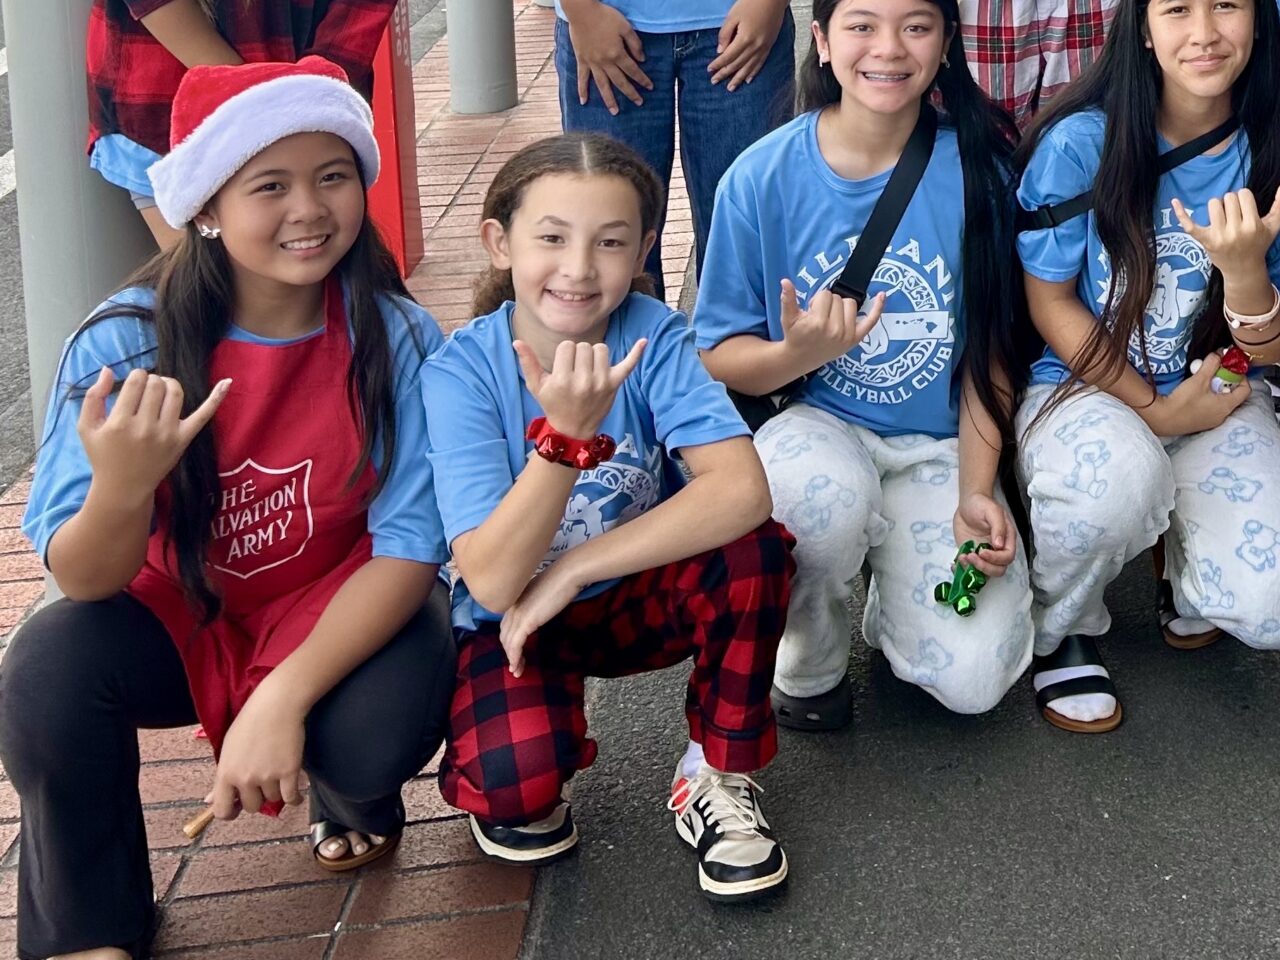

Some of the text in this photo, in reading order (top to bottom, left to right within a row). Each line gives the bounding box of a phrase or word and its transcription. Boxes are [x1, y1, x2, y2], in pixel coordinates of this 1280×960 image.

[816, 347, 953, 404] OLLEYBALL CLUB
[226, 510, 292, 564] ARMY
